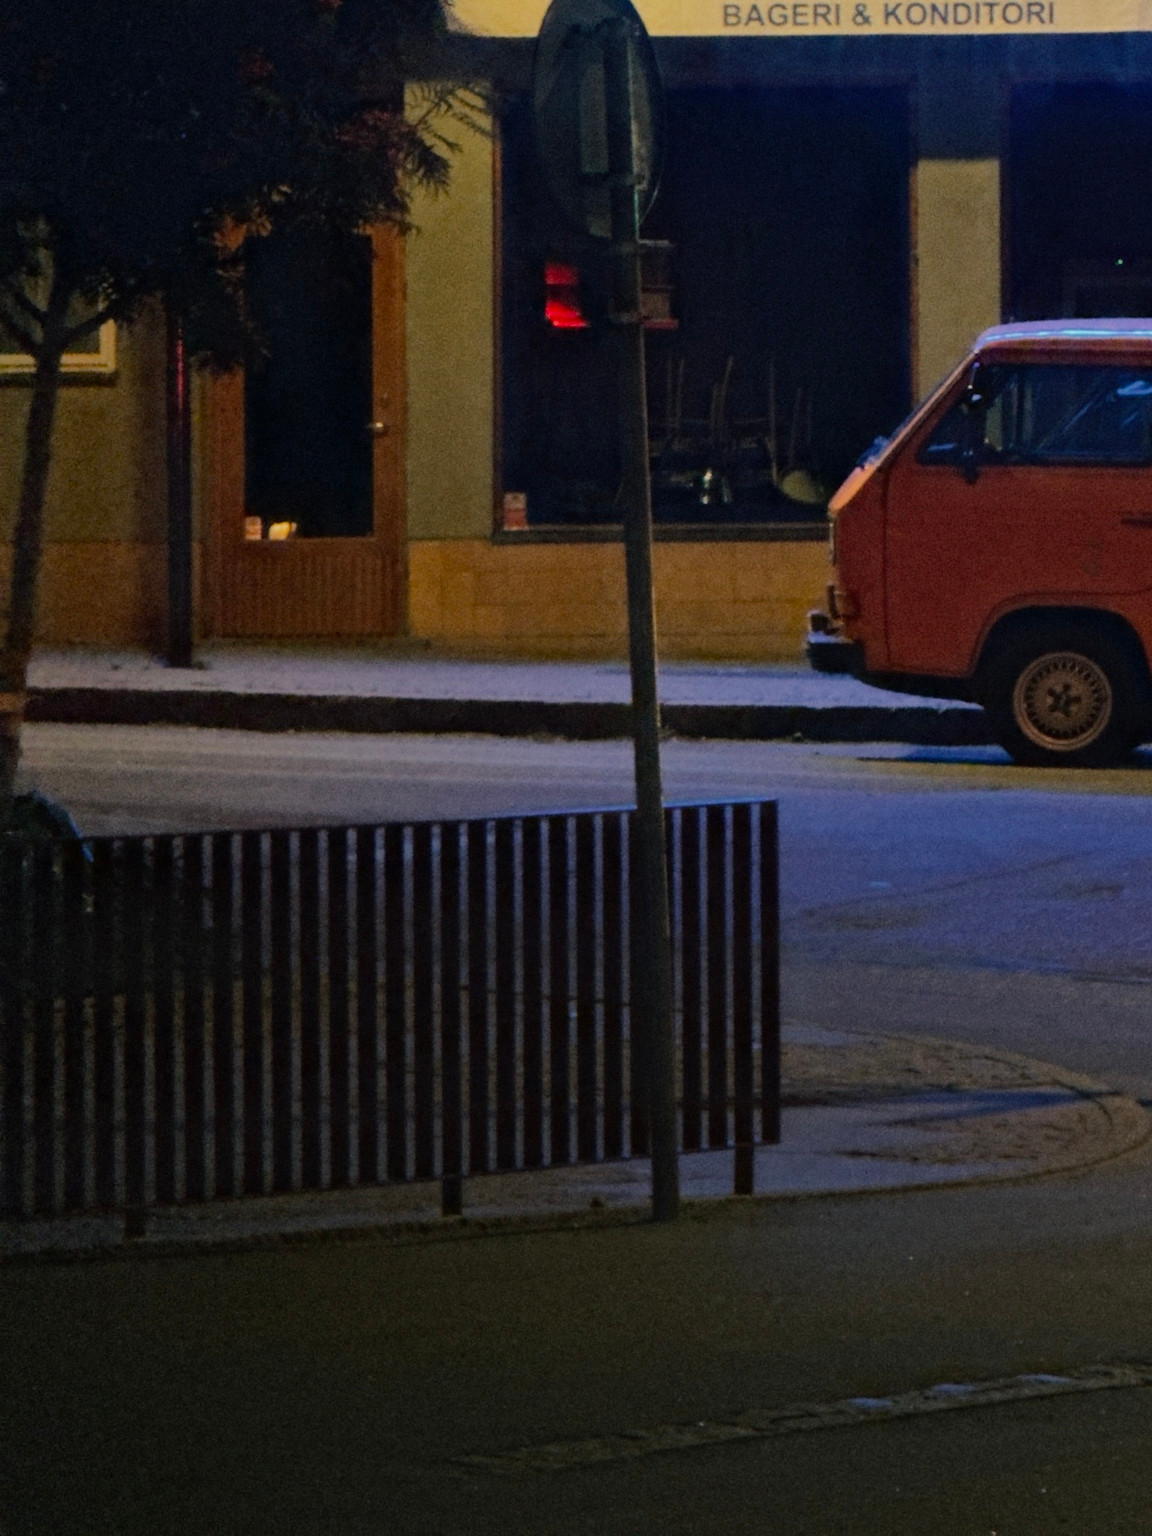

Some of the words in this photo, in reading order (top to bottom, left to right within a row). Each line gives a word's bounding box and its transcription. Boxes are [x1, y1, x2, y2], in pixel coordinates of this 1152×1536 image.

[723, 3, 841, 27] BAGERI
[852, 3, 872, 26] &
[883, 2, 1055, 26] KONDITORI
